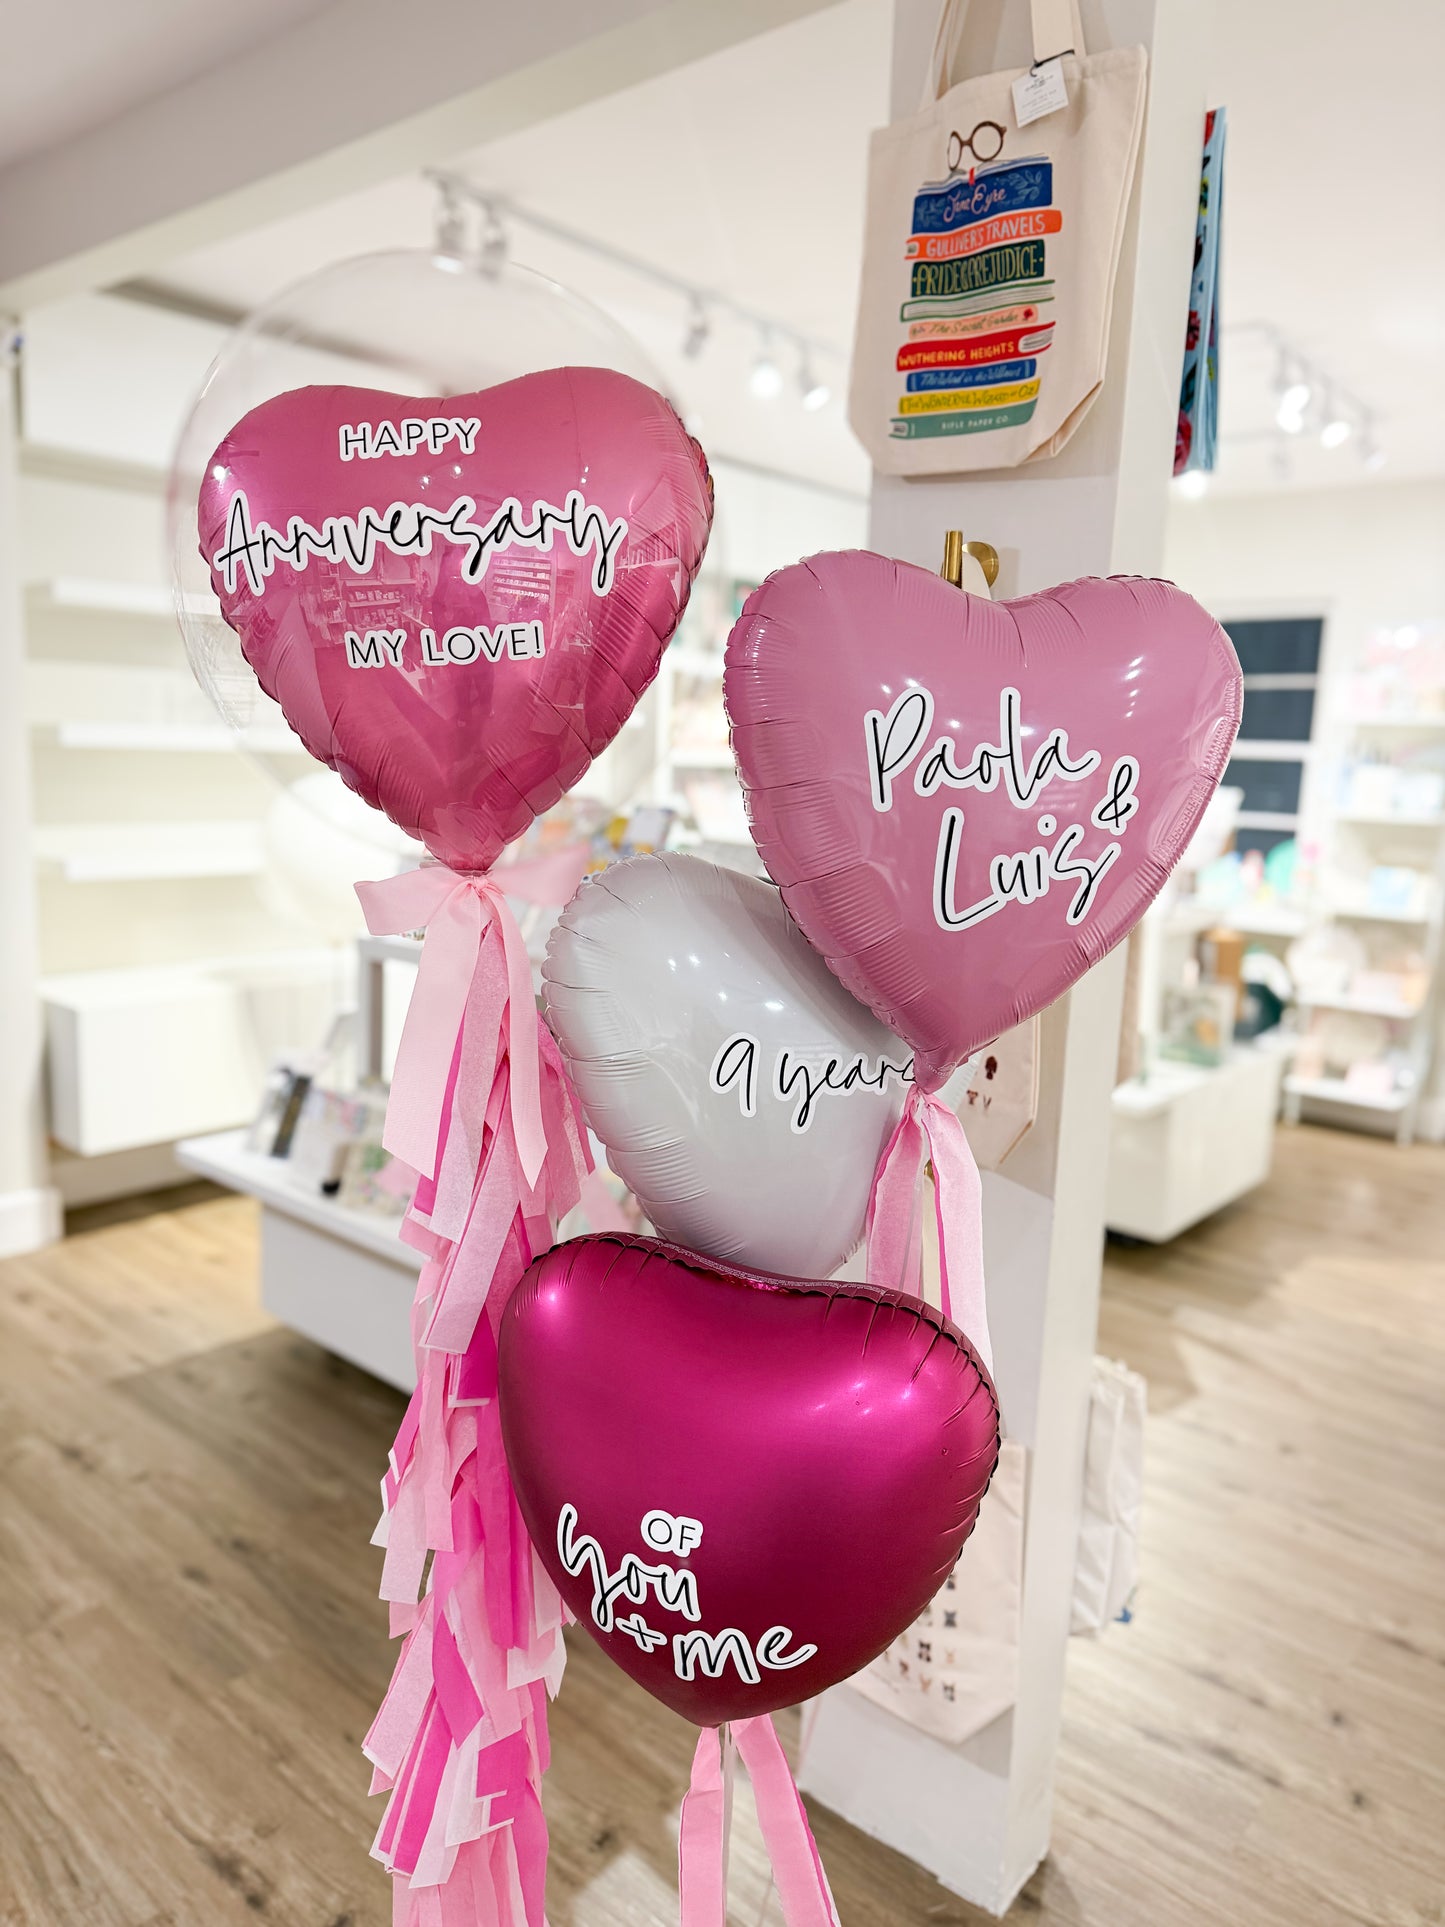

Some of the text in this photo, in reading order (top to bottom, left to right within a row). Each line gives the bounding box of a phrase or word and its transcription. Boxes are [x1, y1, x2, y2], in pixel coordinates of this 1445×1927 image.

[970, 183, 1007, 215] Eyre
[986, 214, 1046, 240] TRAVELS
[899, 341, 1015, 367] WUTHERING HEIGHTS
[344, 421, 477, 456] HAPPY
[218, 497, 622, 589] Anniversary
[350, 625, 543, 664] MY LOVE!
[871, 693, 1133, 829] Paola &
[941, 814, 1115, 925] Luis
[716, 1038, 755, 1112] 9
[647, 1518, 696, 1550] OF
[562, 1511, 695, 1628] you
[680, 1630, 811, 1681] me
